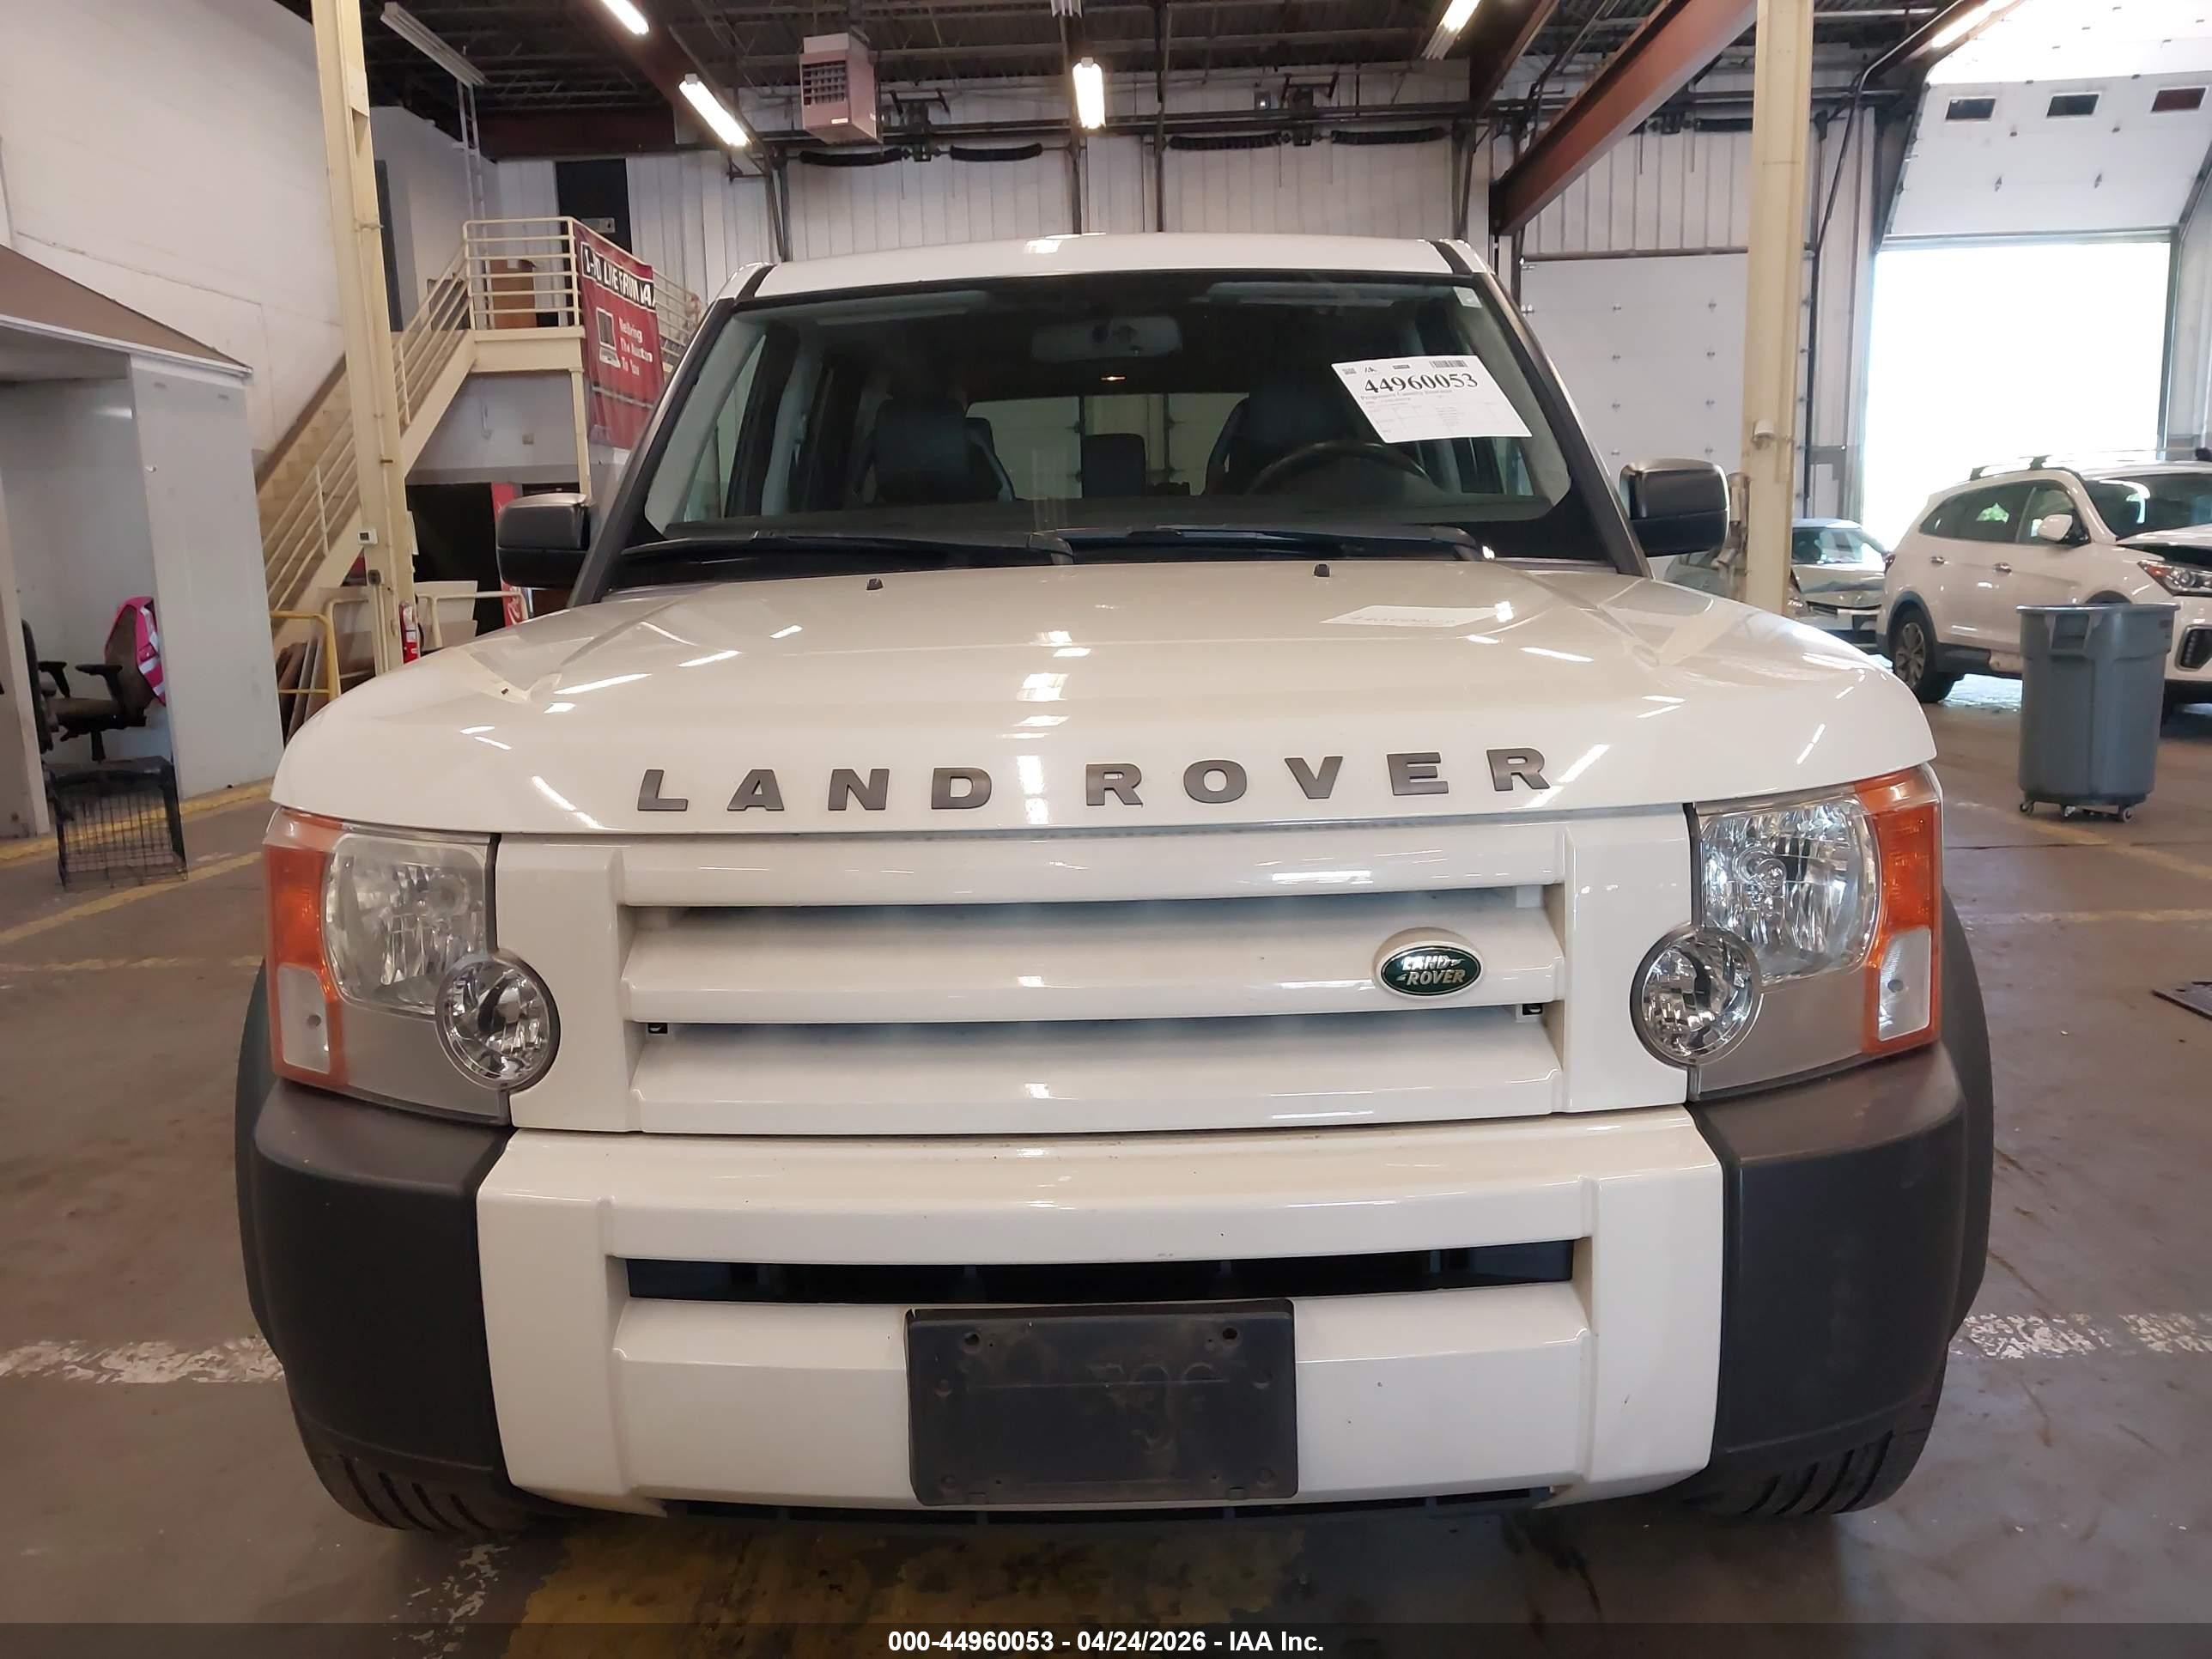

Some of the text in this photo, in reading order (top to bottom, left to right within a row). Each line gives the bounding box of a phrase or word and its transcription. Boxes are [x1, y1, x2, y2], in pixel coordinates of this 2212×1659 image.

[1364, 373, 1478, 393] 44960053
[636, 747, 1552, 812] LAND ROVER
[1401, 955, 1450, 971] LAND
[1406, 969, 1466, 986] ROVER
